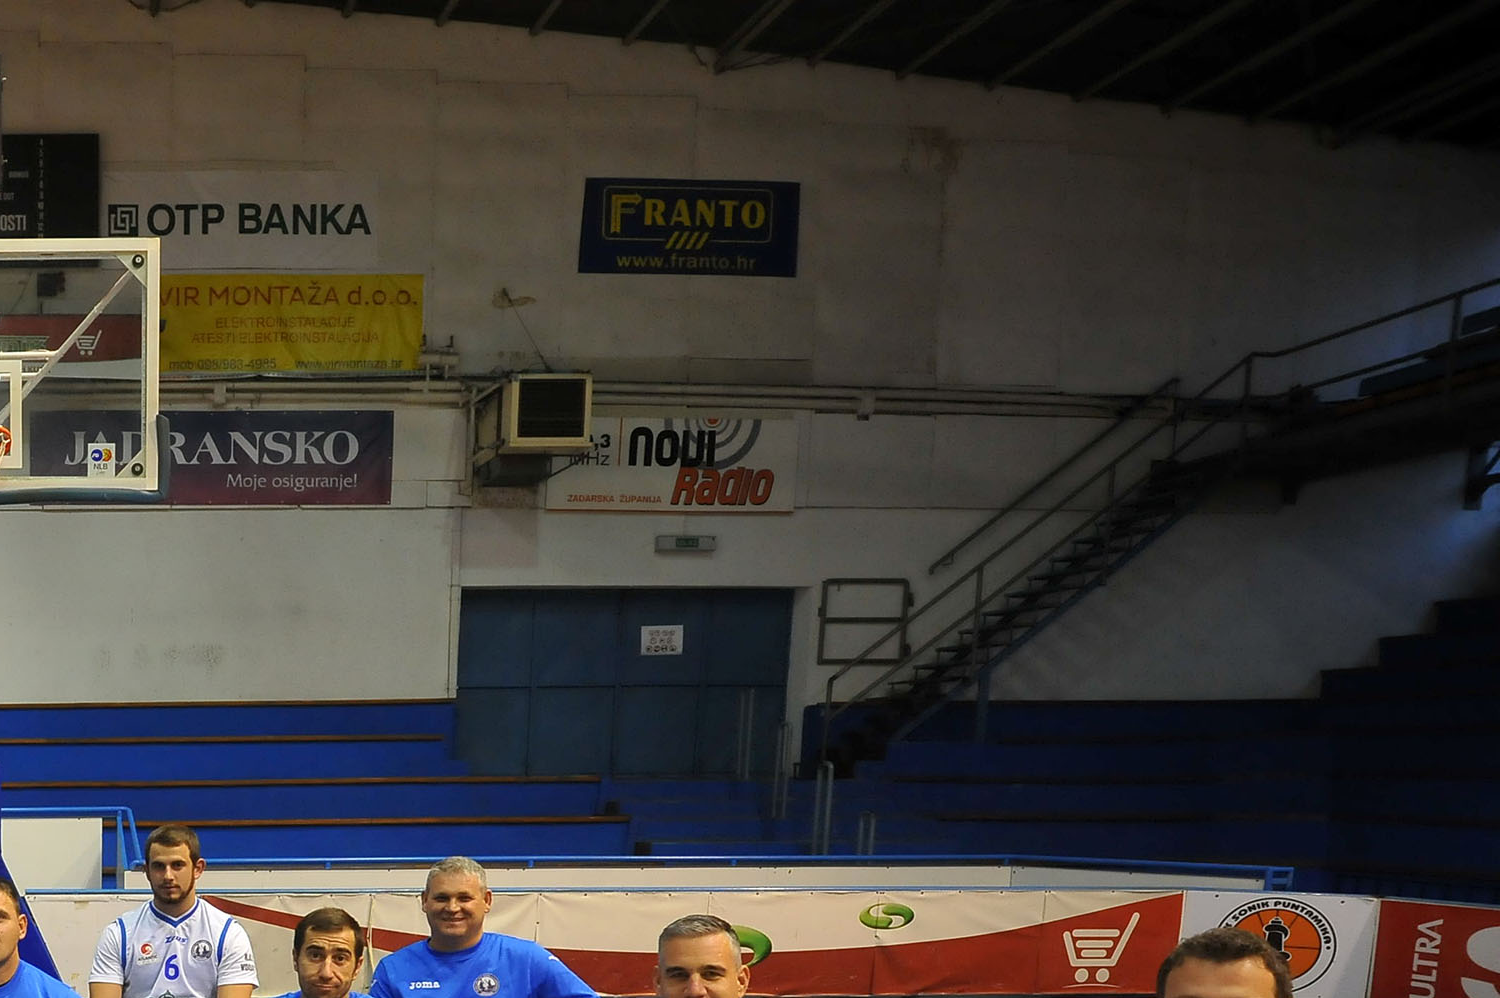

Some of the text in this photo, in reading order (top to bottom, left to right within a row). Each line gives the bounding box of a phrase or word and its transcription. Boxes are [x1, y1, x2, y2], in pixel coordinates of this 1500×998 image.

[147, 203, 372, 236] OTP BANKA
[610, 193, 766, 234] FRANTO
[616, 253, 757, 270] www.franto.hr
[160, 280, 418, 307] VIR MONTAŽA d.o.o.
[215, 316, 355, 329] ELEKTROINSTALACIJE
[226, 473, 359, 490] Moje osiguranje!
[670, 466, 775, 506] Radio
[567, 493, 662, 504] ZADARSKA ŽUPANIJA
[1232, 900, 1333, 945] SONIK PUNTAMIKA
[164, 954, 180, 981] 6
